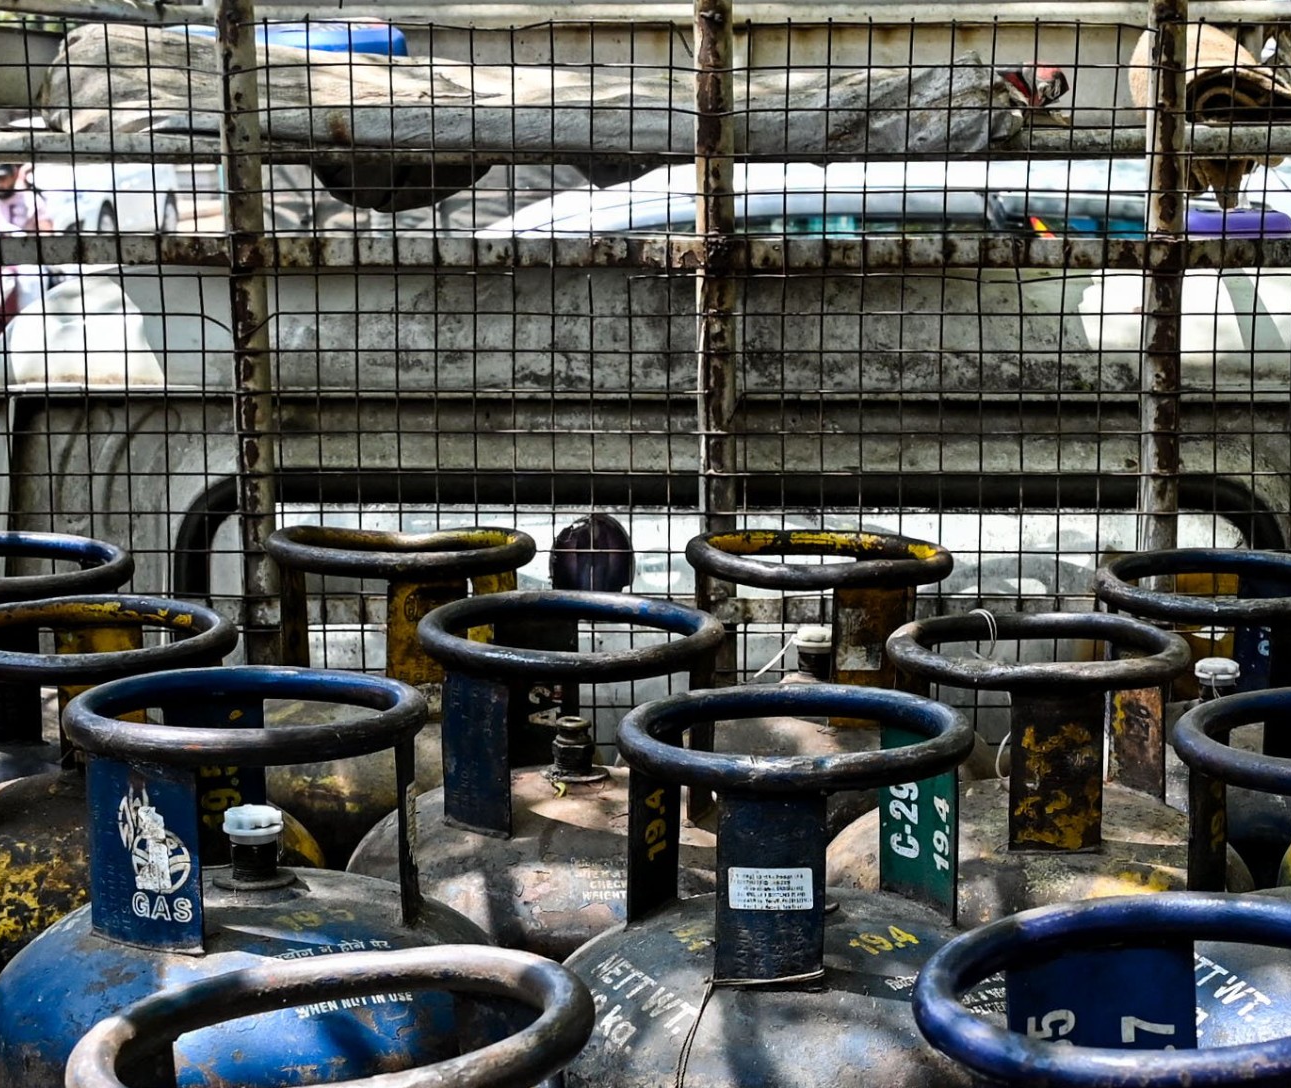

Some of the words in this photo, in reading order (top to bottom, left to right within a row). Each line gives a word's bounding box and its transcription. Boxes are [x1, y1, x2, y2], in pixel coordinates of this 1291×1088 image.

[933, 796, 950, 871] 19.4
[132, 891, 193, 923] GAS
[849, 925, 920, 956] 19.4
[590, 953, 658, 1000] NETT
[296, 1000, 339, 1019] WHEN
[372, 993, 386, 1003] IN
